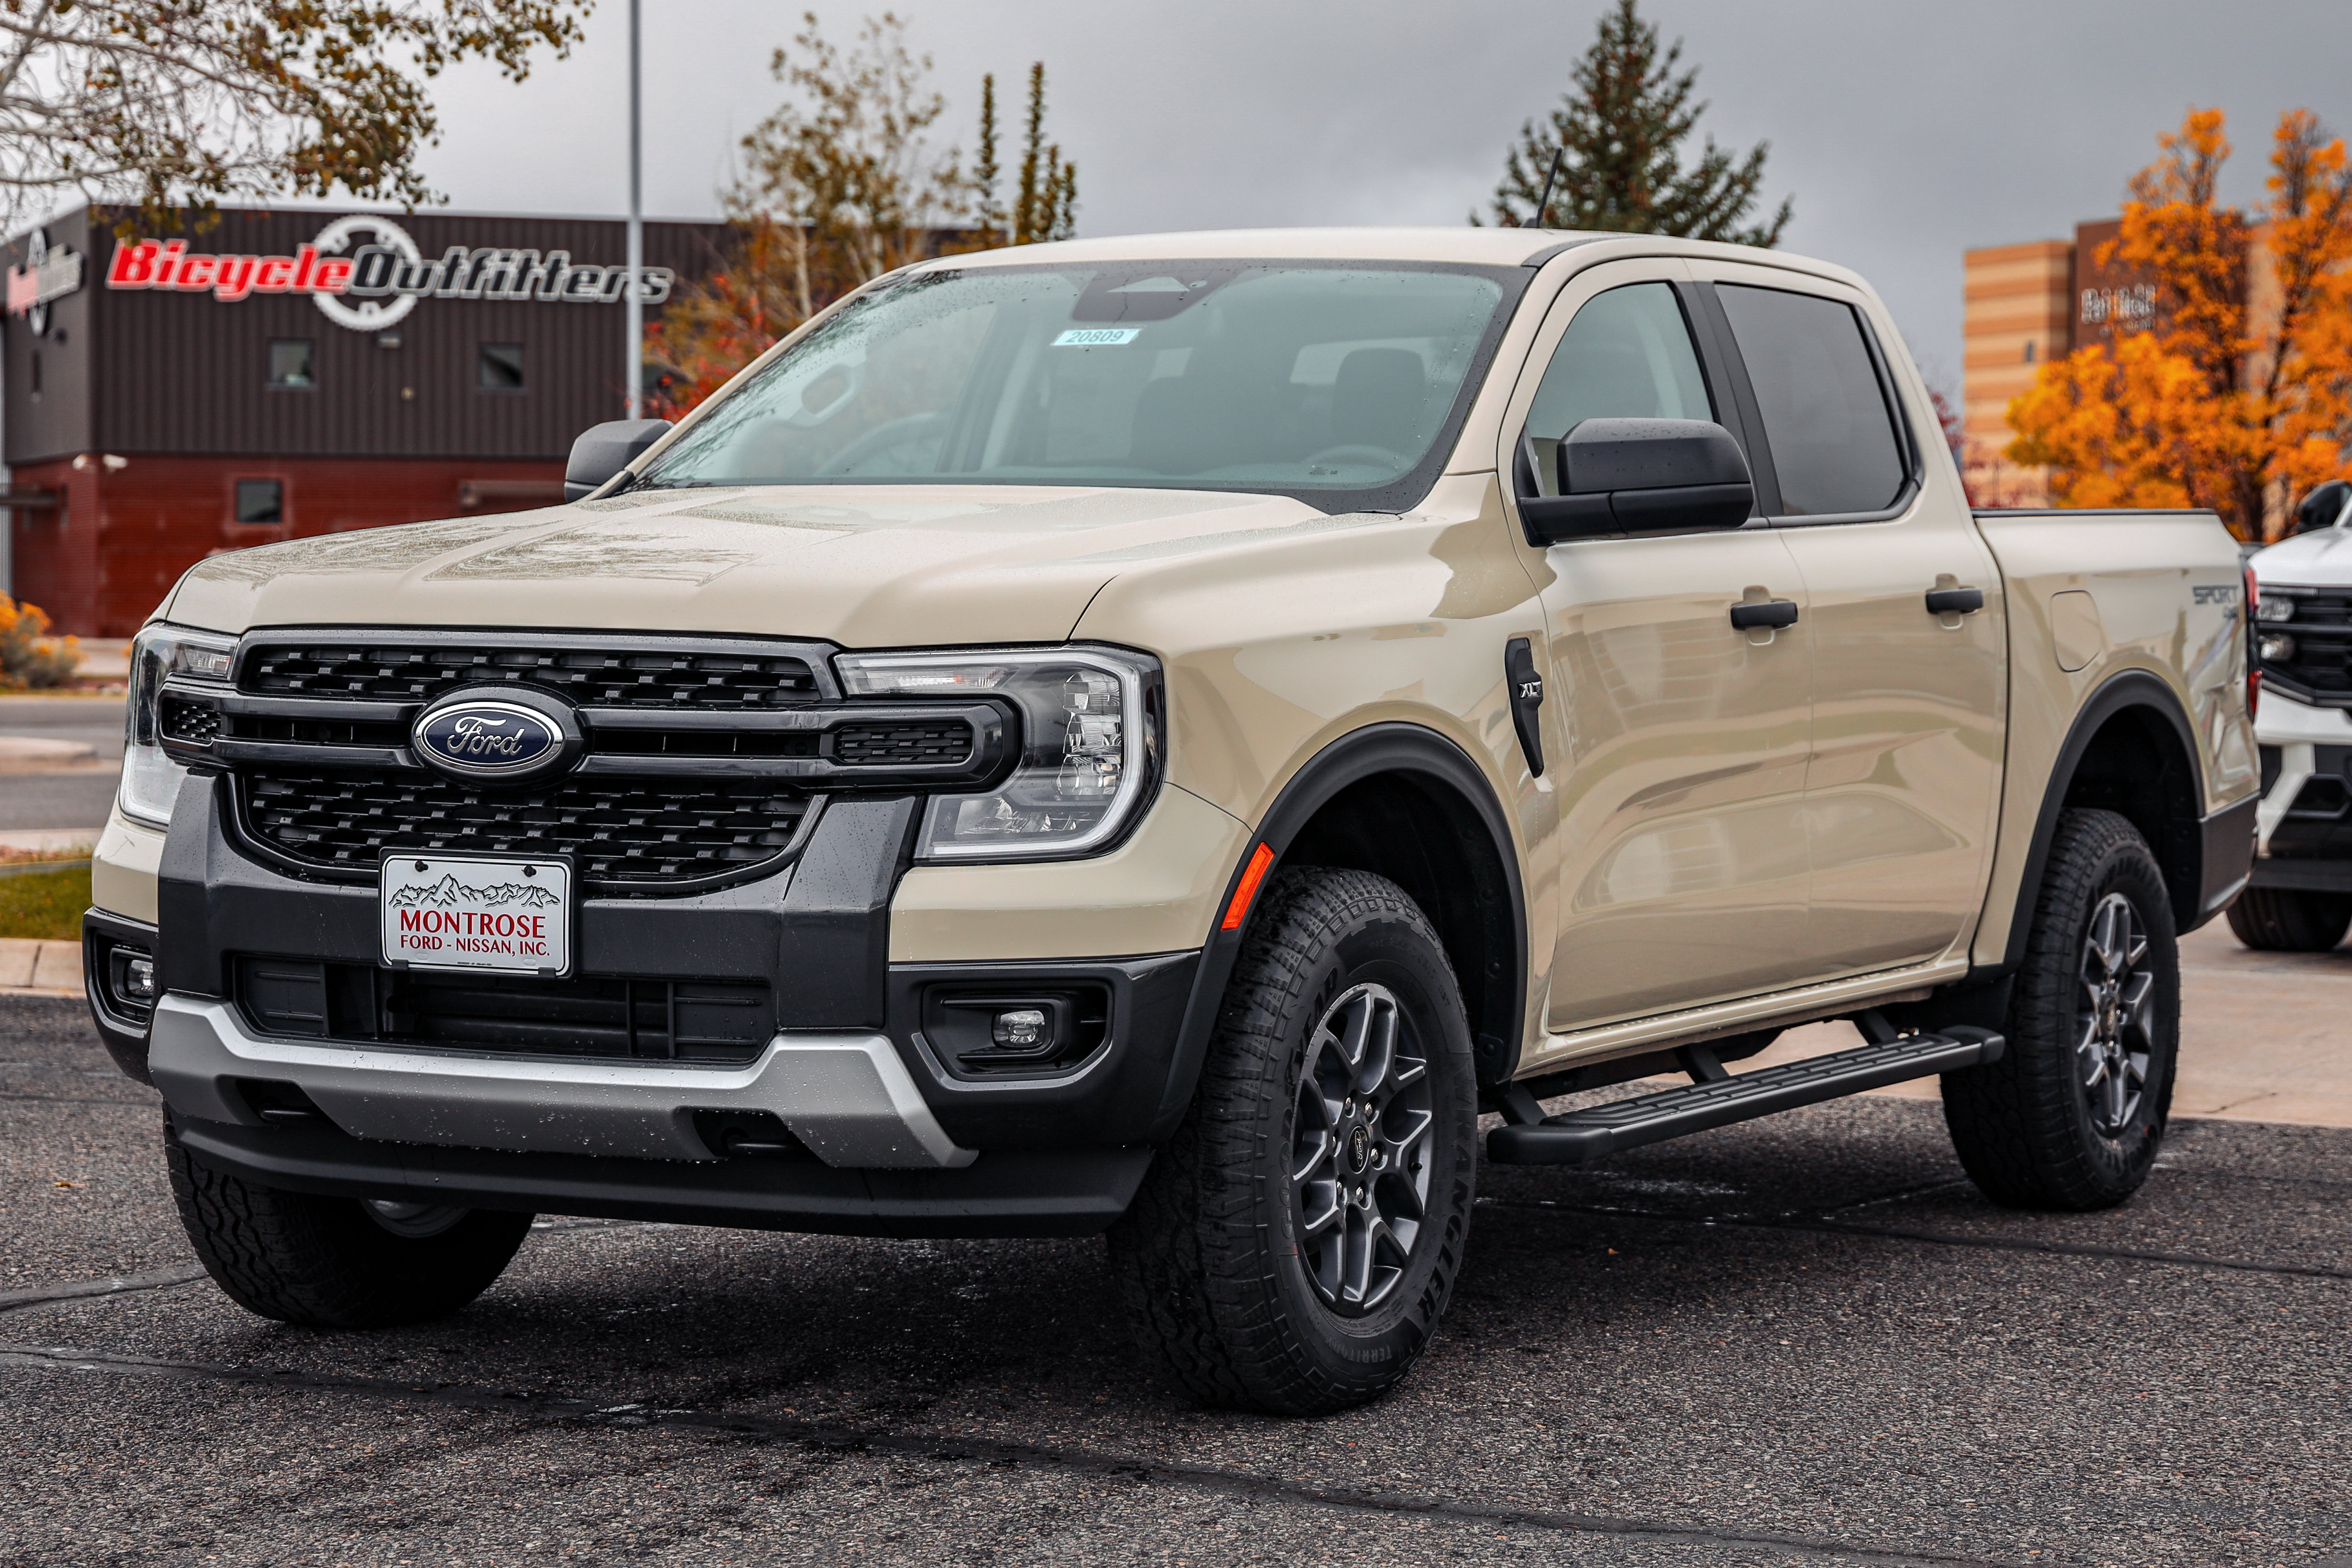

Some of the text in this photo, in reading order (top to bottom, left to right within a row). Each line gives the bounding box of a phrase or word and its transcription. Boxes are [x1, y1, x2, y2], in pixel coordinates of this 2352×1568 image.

[106, 237, 355, 302] Bicycle
[350, 245, 675, 304] Outfitters
[1065, 331, 1125, 343] 20809
[1519, 681, 1541, 698] XLT
[448, 716, 525, 756] Ford
[400, 909, 546, 938] MONTROSE
[400, 935, 443, 950] FORD
[456, 938, 515, 957] NISSAN,
[520, 941, 550, 956] INC.
[1416, 1064, 1473, 1324] WRANGLER
